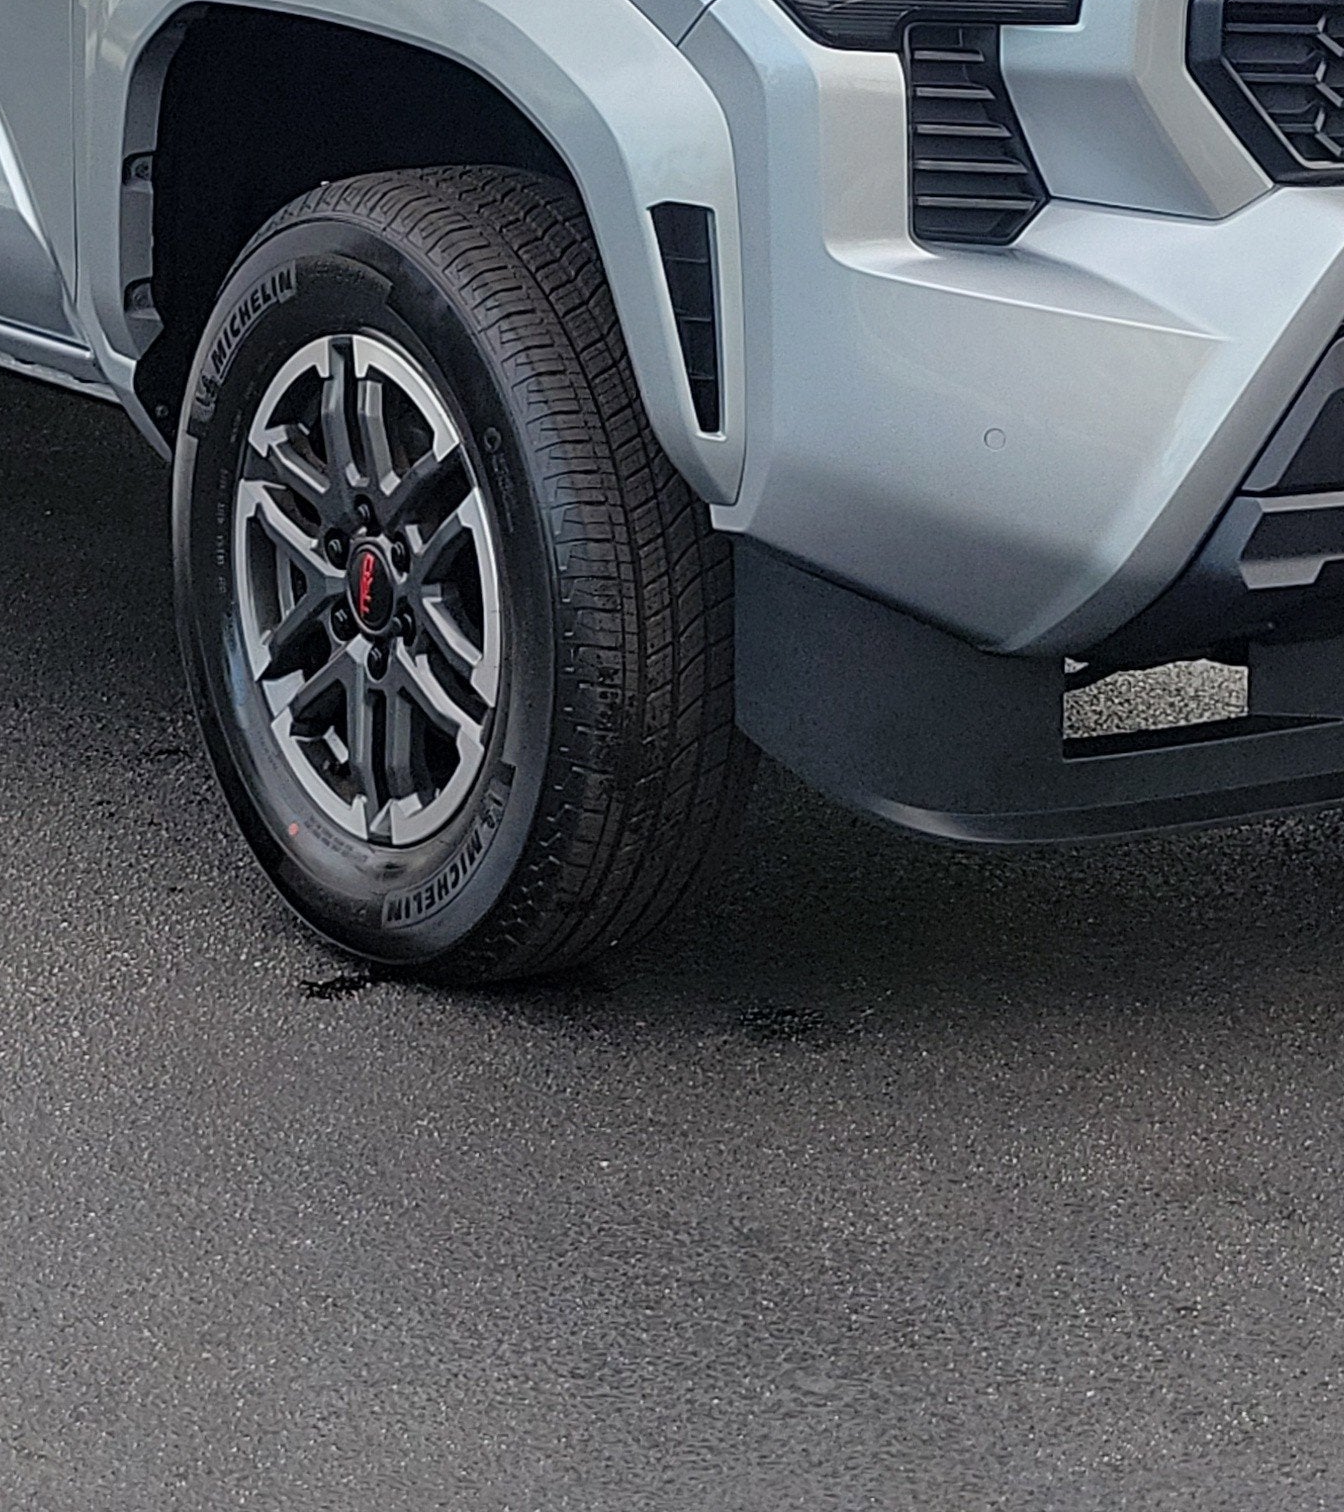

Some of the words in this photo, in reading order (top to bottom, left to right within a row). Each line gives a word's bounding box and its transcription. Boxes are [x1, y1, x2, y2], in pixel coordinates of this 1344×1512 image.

[210, 267, 293, 375] MICHELIN
[359, 552, 375, 615] TRD
[387, 827, 484, 922] MICHELIN
